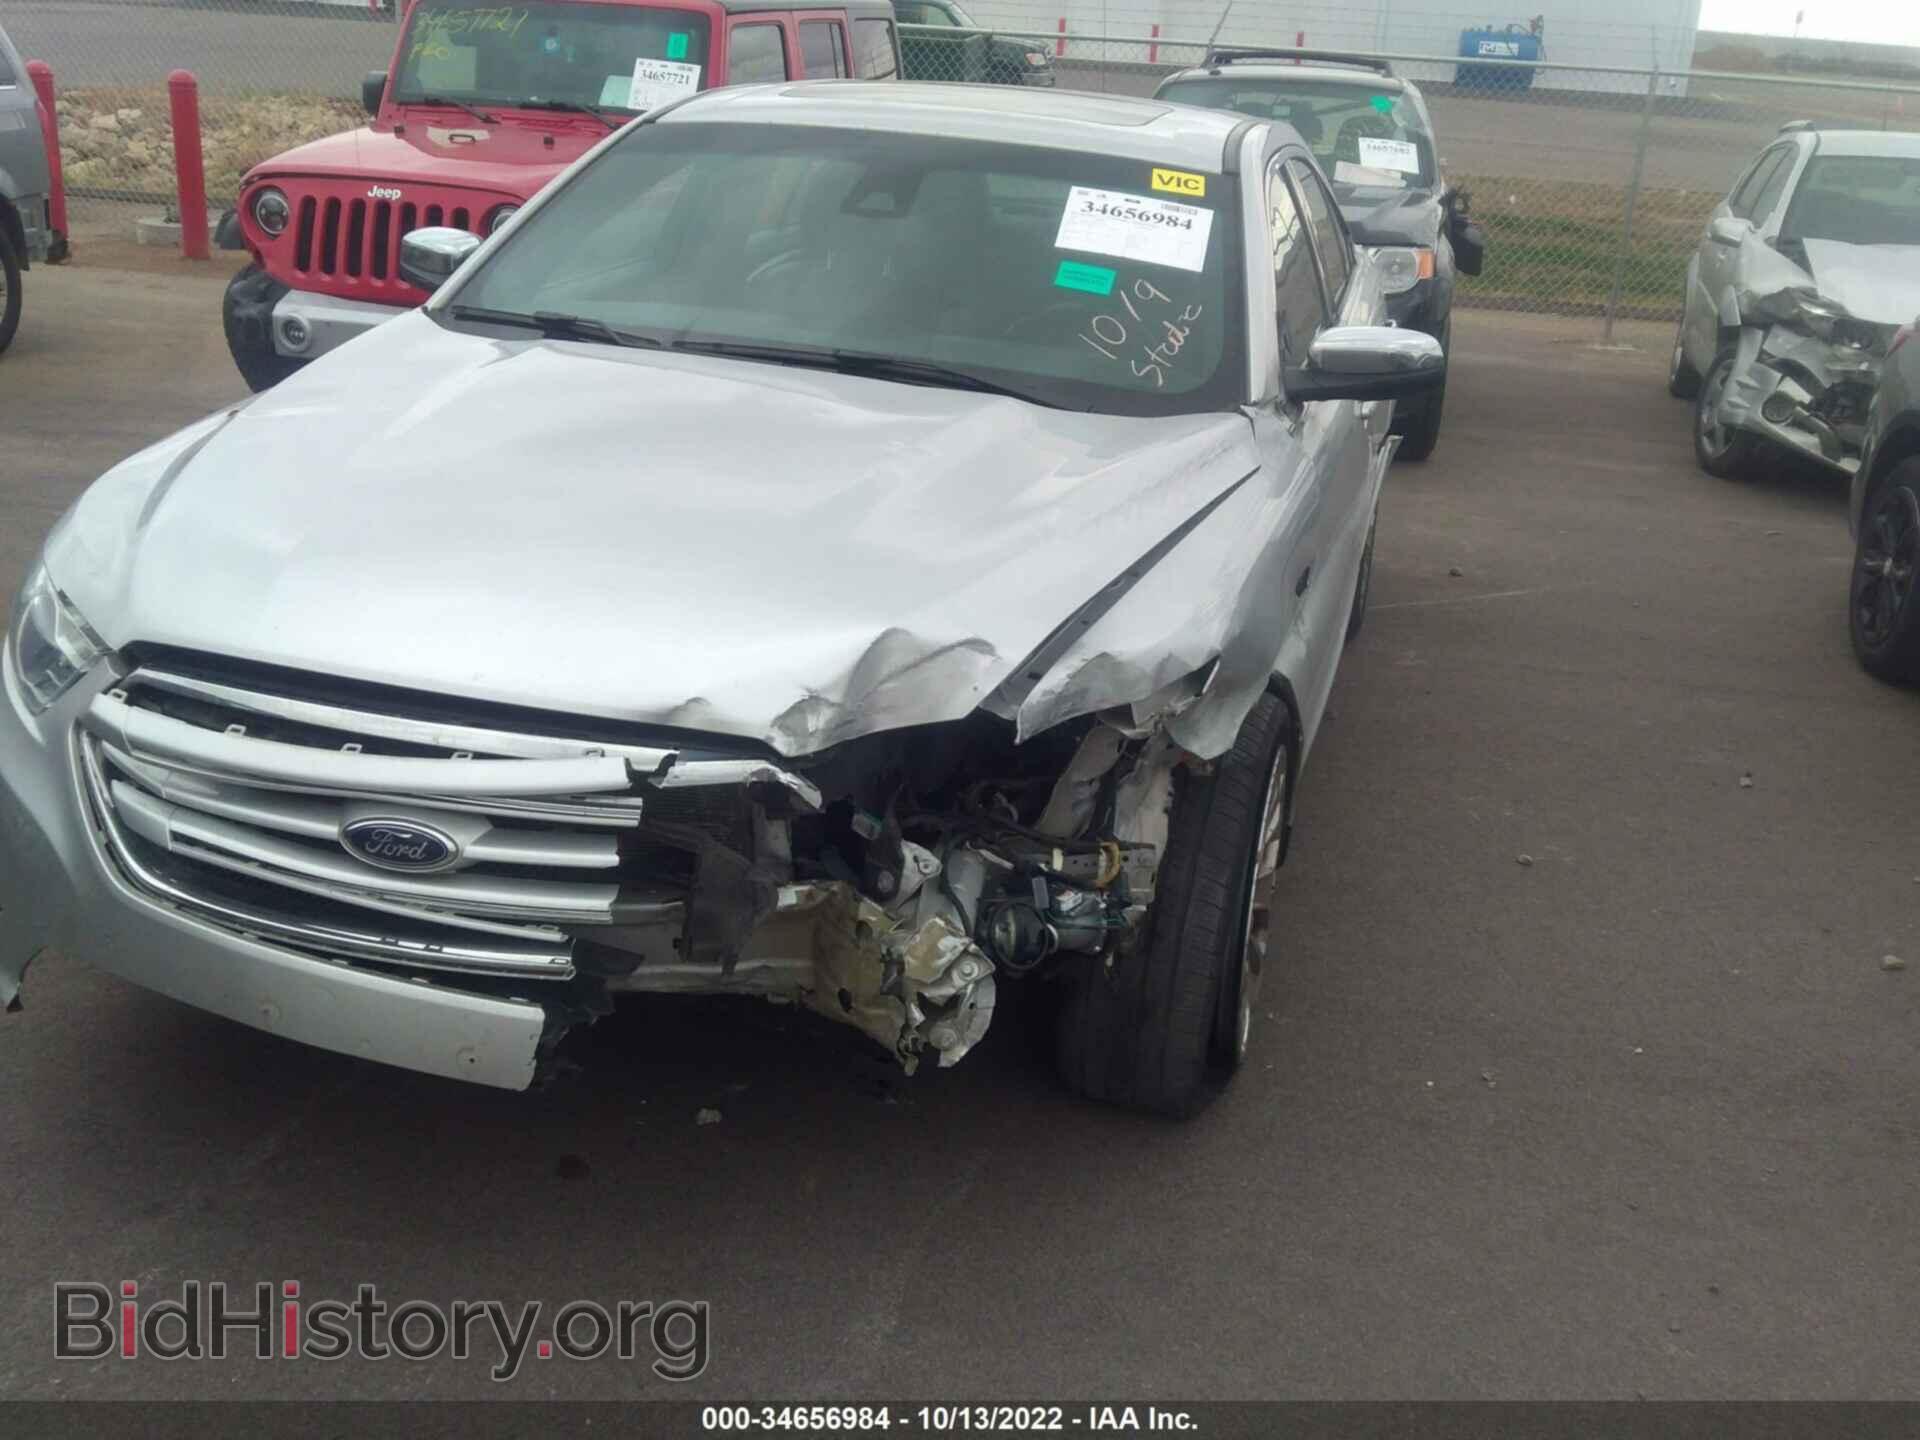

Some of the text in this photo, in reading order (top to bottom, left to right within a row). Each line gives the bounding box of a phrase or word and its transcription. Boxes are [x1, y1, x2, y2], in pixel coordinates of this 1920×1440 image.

[367, 184, 402, 201] Jeep
[1157, 173, 1200, 191] VIC
[1080, 201, 1193, 231] 34656984
[365, 828, 428, 859] Ford
